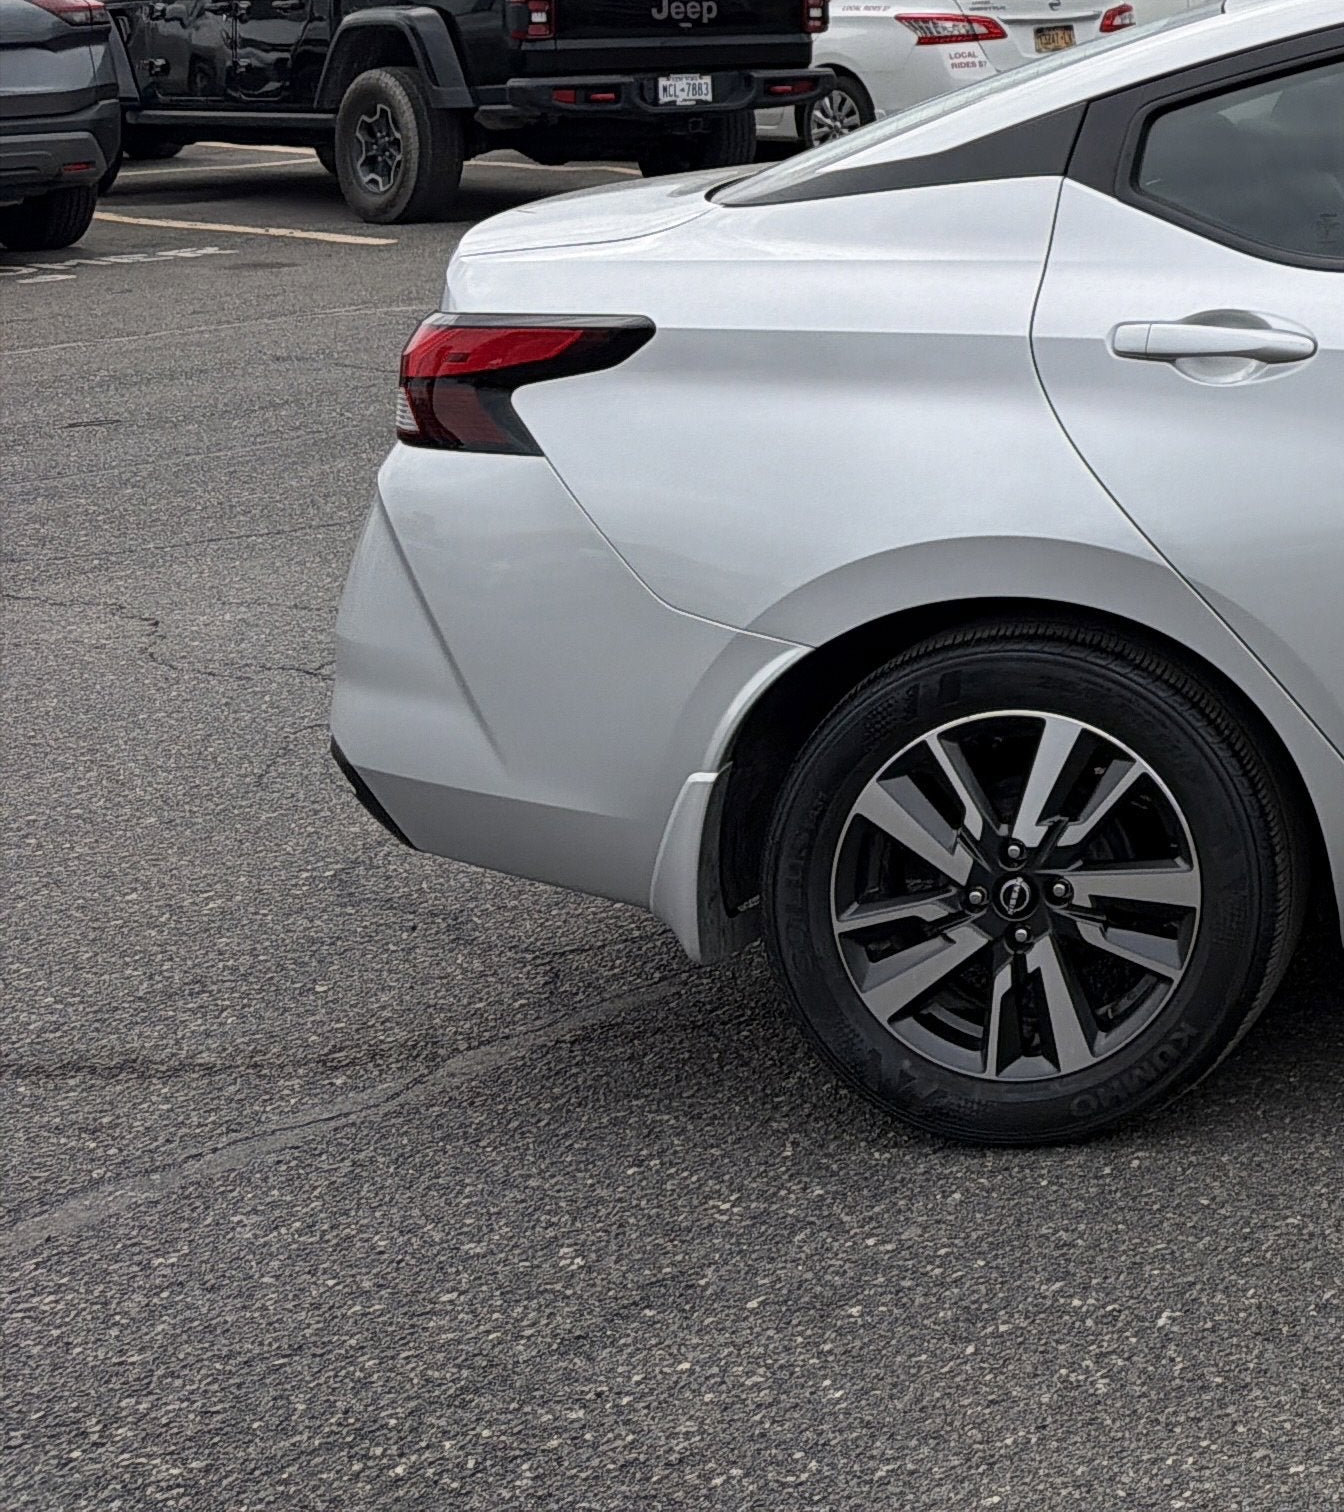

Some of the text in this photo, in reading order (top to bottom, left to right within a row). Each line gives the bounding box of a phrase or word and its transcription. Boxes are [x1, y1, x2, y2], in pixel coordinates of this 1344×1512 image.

[949, 51, 978, 60] LOCAL
[951, 61, 977, 70] RIDES
[1069, 1020, 1200, 1118] KUMHO
